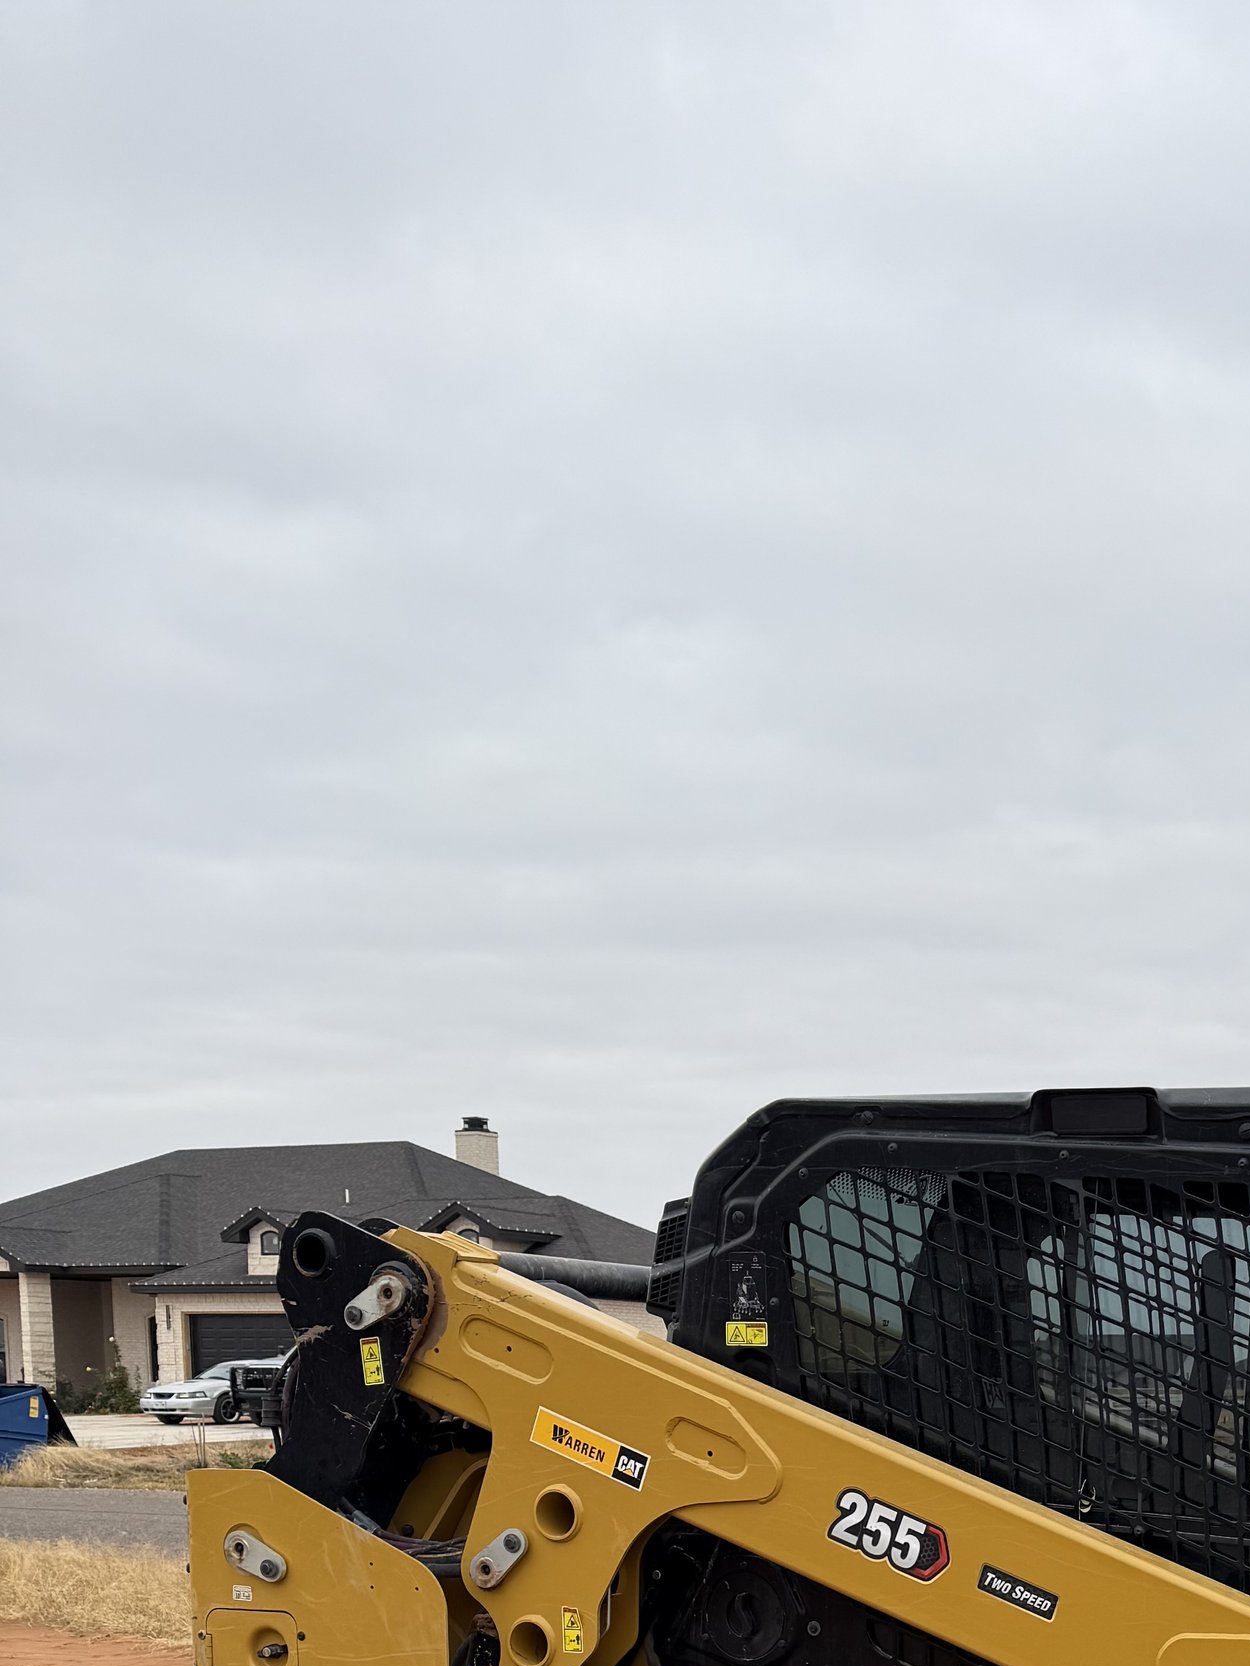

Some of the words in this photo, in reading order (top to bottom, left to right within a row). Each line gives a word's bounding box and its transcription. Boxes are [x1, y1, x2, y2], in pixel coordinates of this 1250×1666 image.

[552, 1424, 605, 1462] WARREN
[617, 1455, 645, 1479] CAT
[831, 1492, 927, 1569] 255
